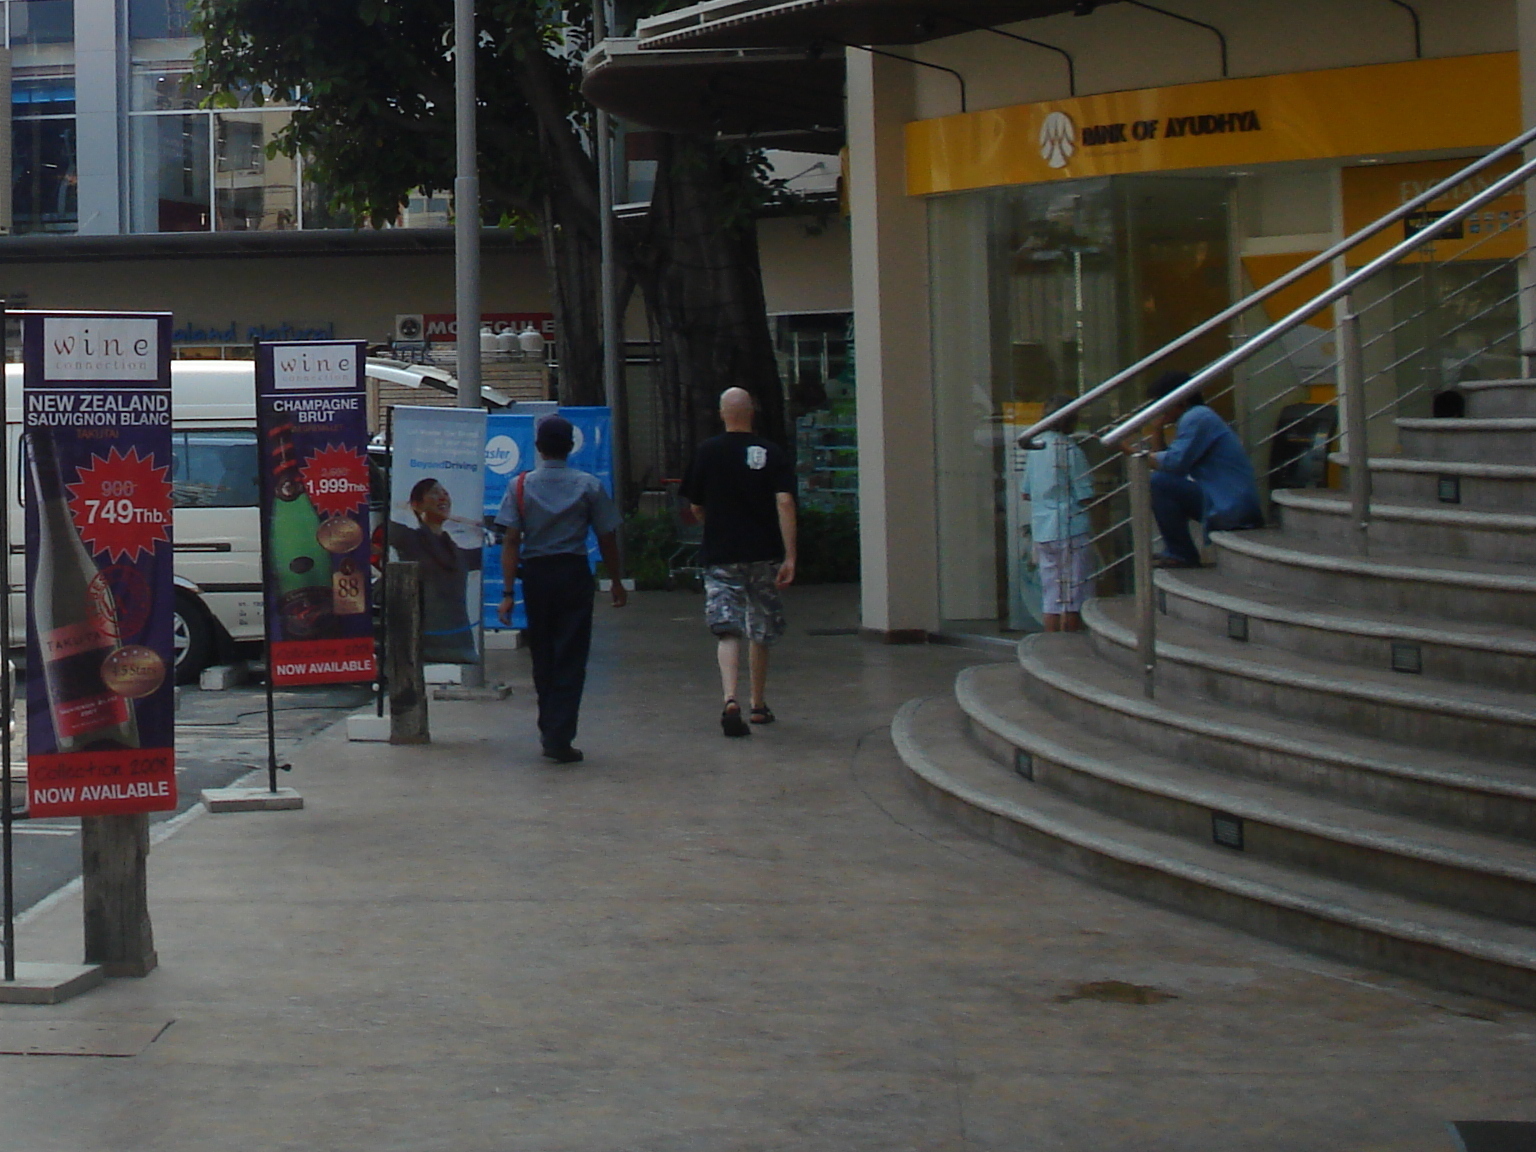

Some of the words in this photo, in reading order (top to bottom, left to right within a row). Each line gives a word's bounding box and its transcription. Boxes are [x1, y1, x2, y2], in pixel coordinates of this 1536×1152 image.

[1082, 123, 1127, 146] BANK
[1132, 120, 1159, 141] OF
[1165, 110, 1261, 138] AYUDHYA
[427, 319, 556, 335] MOECULE
[54, 329, 149, 356] wine
[55, 360, 147, 371] connection
[280, 353, 350, 373] wine
[29, 395, 75, 412] NEW
[79, 395, 169, 412] ZEALAND
[273, 398, 359, 412] CHAMPAGNE
[27, 412, 116, 426] SAUVIGNON
[120, 412, 170, 426] BLANC
[298, 411, 335, 423] BRUT
[102, 480, 134, 496] 900
[338, 578, 359, 598] 88
[277, 664, 306, 676] NOW
[309, 659, 372, 674] AVAILABLE
[34, 786, 76, 804] NOW
[80, 781, 170, 801] AVAILABLE
